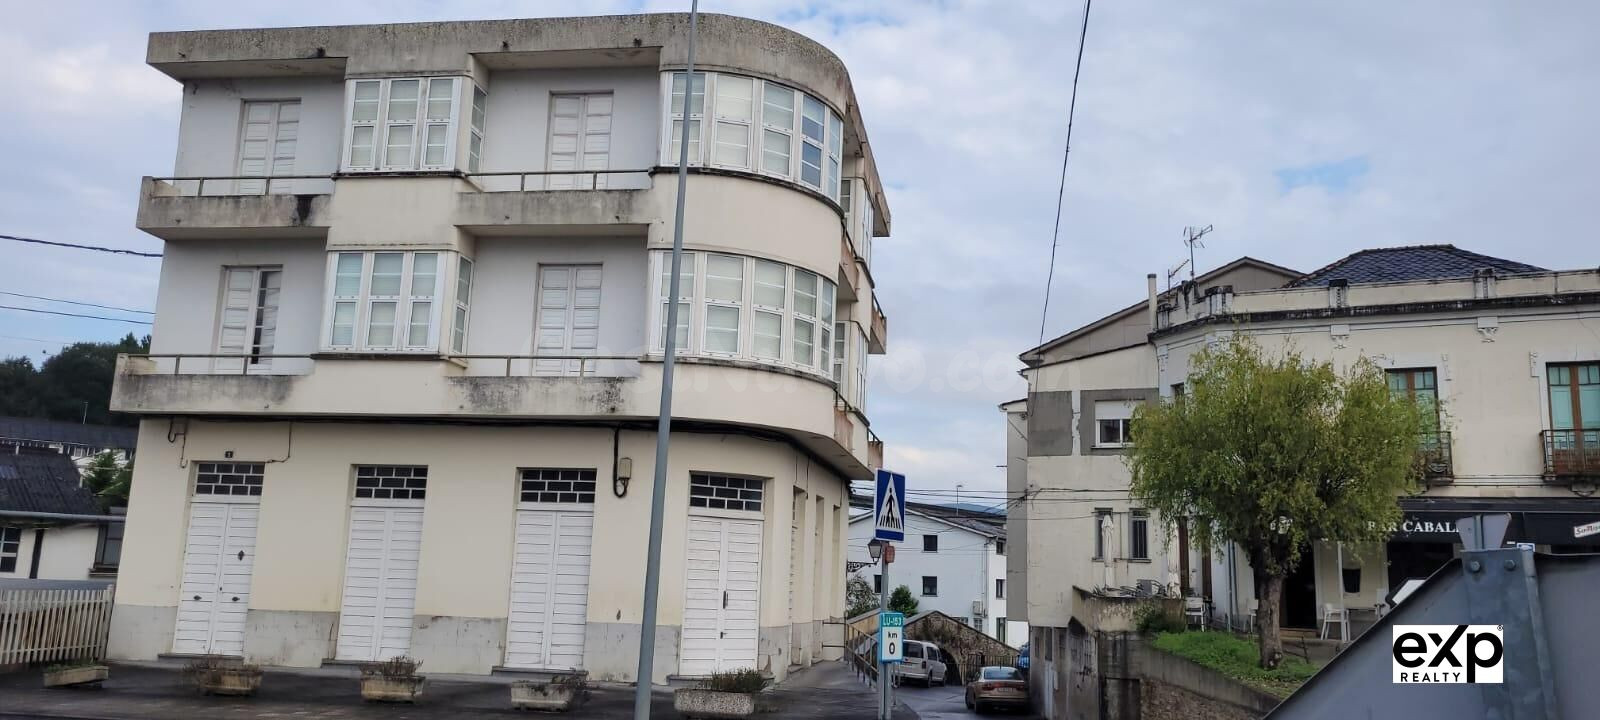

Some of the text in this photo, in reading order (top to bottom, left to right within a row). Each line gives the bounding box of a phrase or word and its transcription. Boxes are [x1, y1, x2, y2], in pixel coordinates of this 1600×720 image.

[1367, 521, 1460, 533] BAR CABAL
[889, 642, 895, 655] 0
